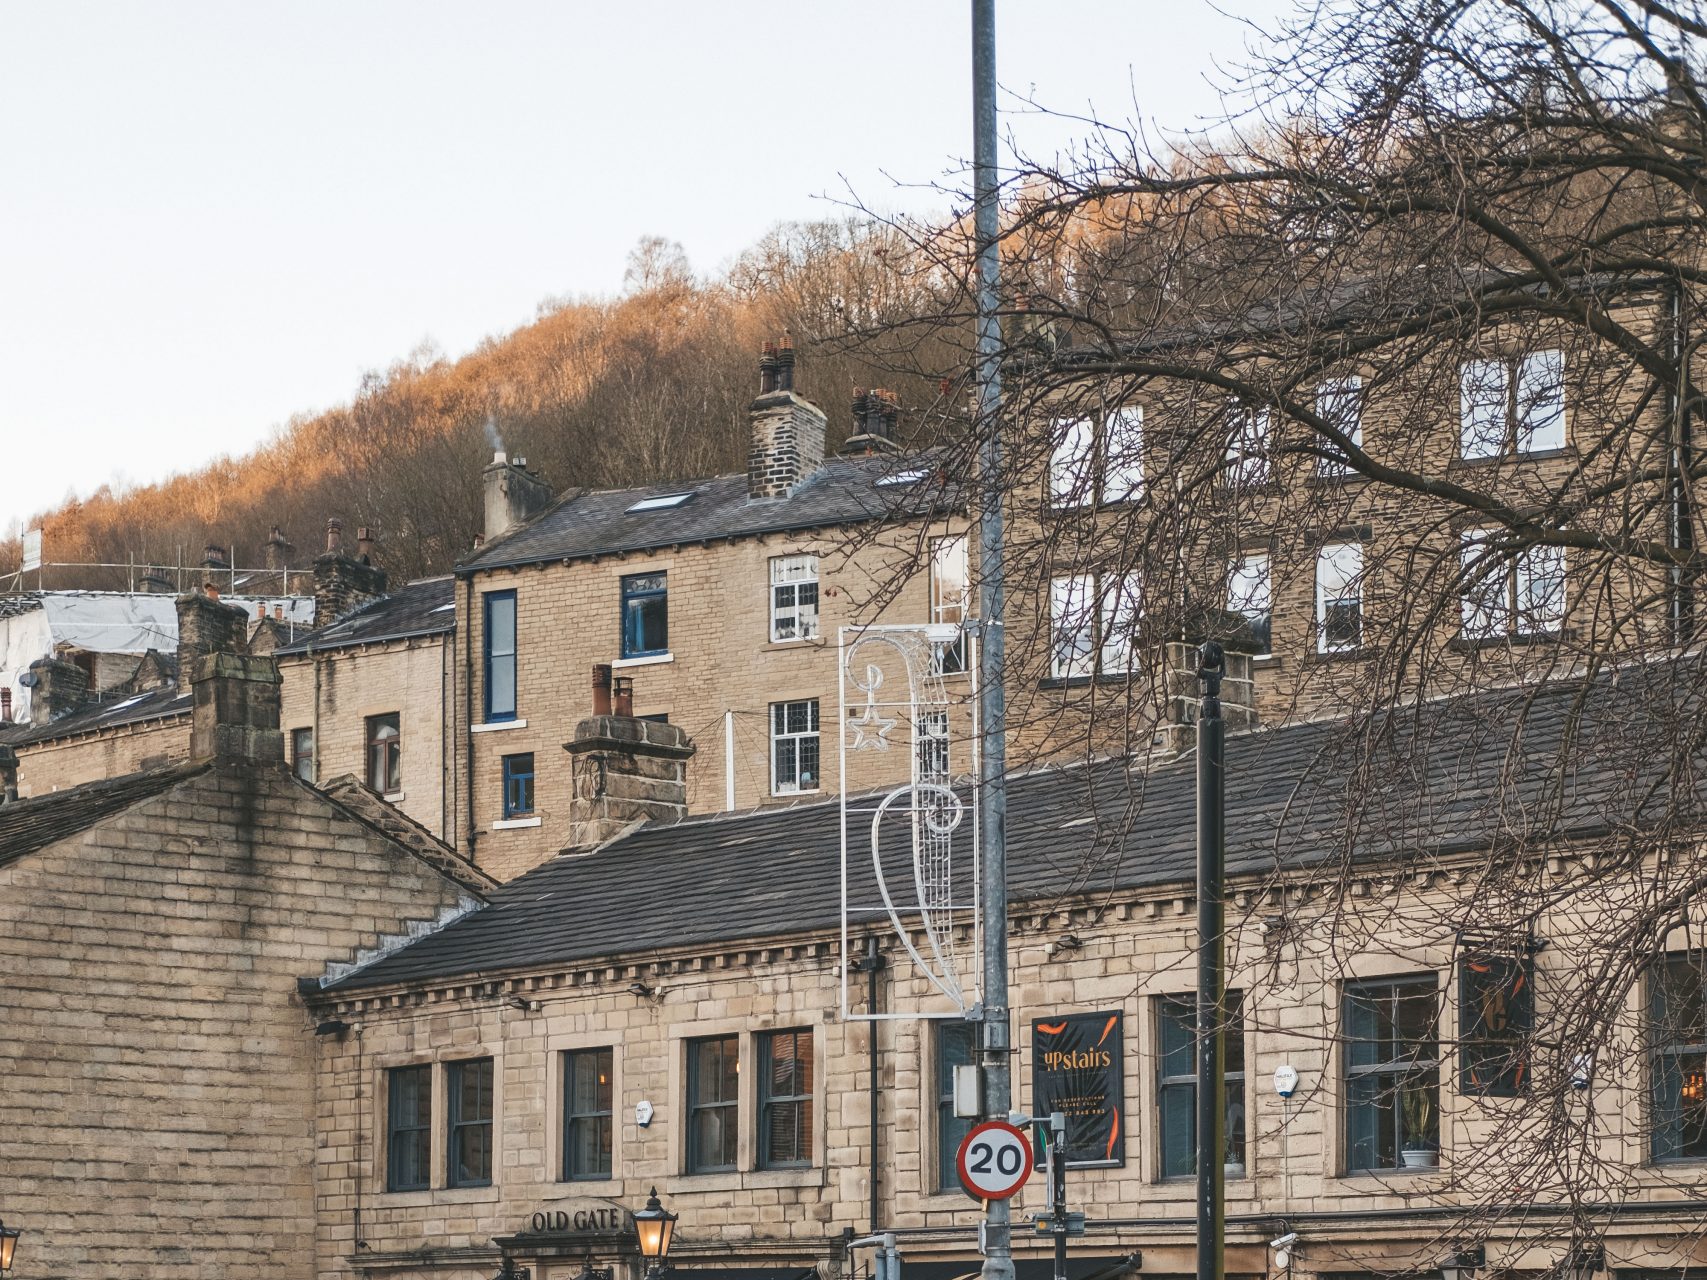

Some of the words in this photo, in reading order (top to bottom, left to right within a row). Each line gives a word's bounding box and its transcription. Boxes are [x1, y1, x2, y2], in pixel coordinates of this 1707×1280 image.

[1044, 1046, 1111, 1072] upstairs
[970, 1142, 1022, 1176] 20
[532, 1210, 569, 1232] OLD
[573, 1208, 619, 1230] GATE
